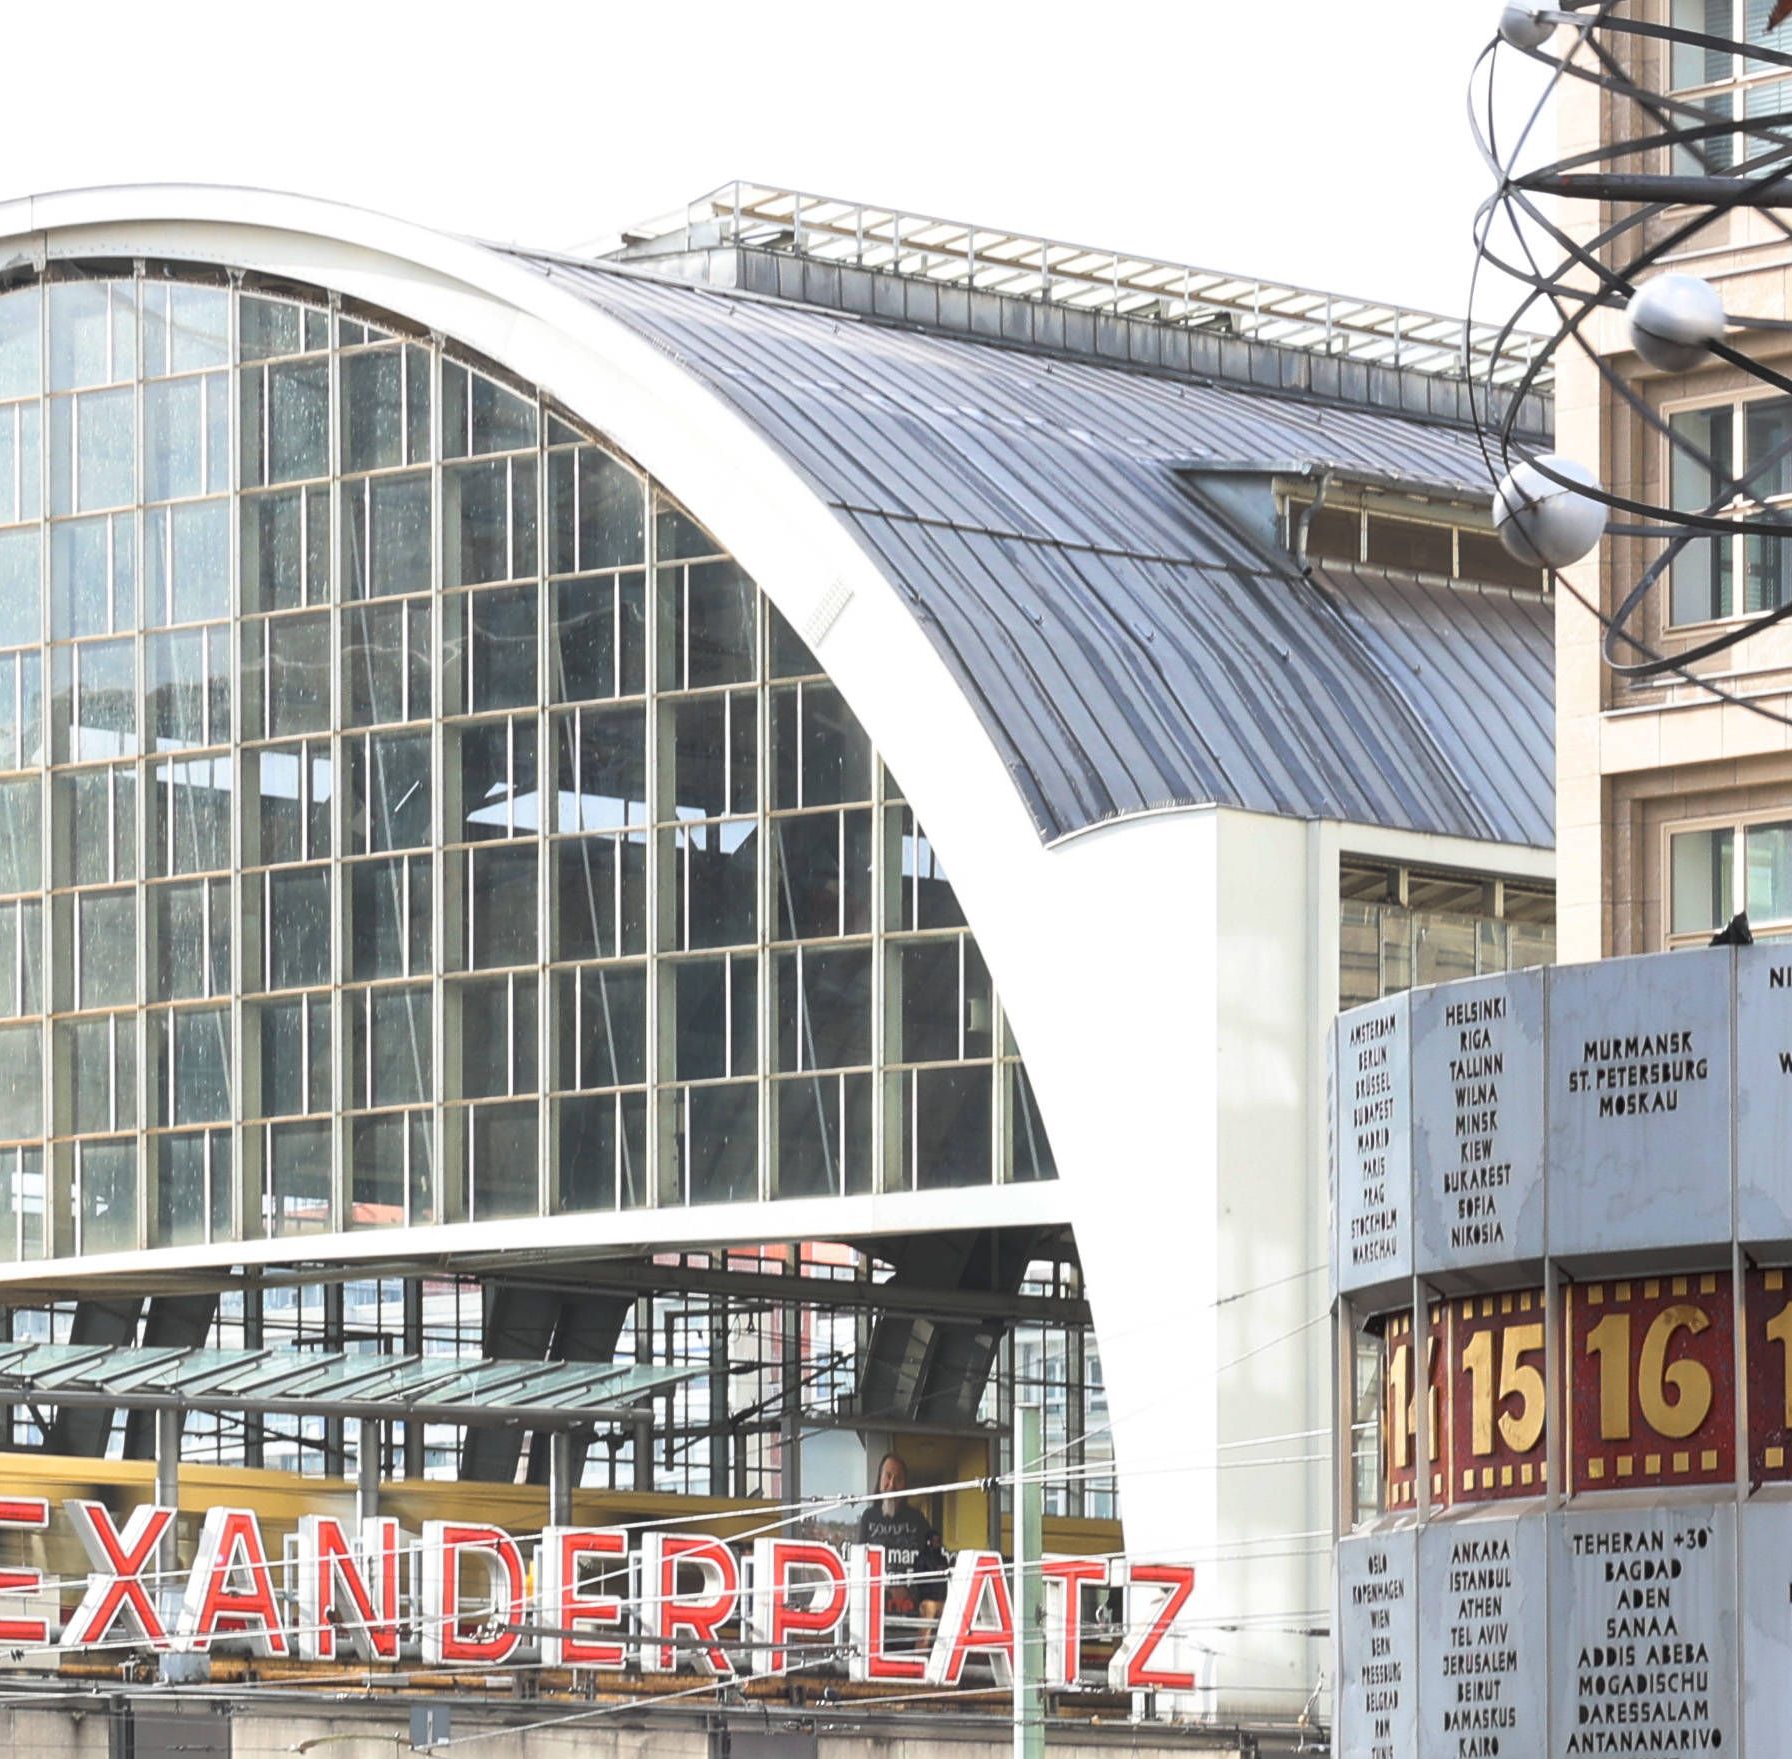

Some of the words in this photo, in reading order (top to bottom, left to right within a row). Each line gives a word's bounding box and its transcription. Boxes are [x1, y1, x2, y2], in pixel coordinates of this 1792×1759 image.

[1445, 996, 1507, 1027] HELSINKI
[1350, 1014, 1396, 1044] AMSTERDAM
[1460, 1028, 1492, 1053] RIGA
[1358, 1046, 1387, 1072] BERLIN
[1583, 1031, 1693, 1063] MURMANSK
[1449, 1052, 1503, 1082] TALLINN
[1569, 1069, 1592, 1093] ST.
[1593, 1051, 1708, 1090] PETERSBURG
[1355, 1071, 1391, 1101] BRÜSSEL
[1455, 1082, 1498, 1108] WILNA
[1353, 1097, 1394, 1128] BUDAPEST
[1599, 1089, 1678, 1118] MOSKAU
[1455, 1109, 1498, 1137] MINSK
[1357, 1127, 1390, 1151] MADRID
[1461, 1138, 1493, 1164] KIEW
[1363, 1156, 1385, 1179] PARIS
[1444, 1163, 1512, 1194] BUKAREST
[1363, 1183, 1385, 1207] PRAG
[1458, 1195, 1496, 1220] SOFIA
[1351, 1208, 1397, 1239] STOCKHOLM
[1451, 1222, 1504, 1248] NIKOSIA
[1351, 1233, 1397, 1265] WARSCHAU
[1587, 1304, 1713, 1440] 16
[1462, 1323, 1546, 1457] 15
[1451, 1539, 1510, 1565] ANKARA
[1572, 1530, 1664, 1555] TEHERAN
[1368, 1553, 1387, 1575] OSLO
[1605, 1558, 1682, 1583] BAGDAD
[1352, 1579, 1405, 1605] KOPENHAGEN
[1449, 1567, 1512, 1593] ISTANBUL
[1458, 1596, 1502, 1620] ATHEN
[1617, 1587, 1670, 1610] ADEN
[1370, 1609, 1390, 1629] WIEN
[1606, 1615, 1678, 1639] SANAA
[1371, 1637, 1391, 1658] BERN
[1450, 1626, 1473, 1648] TEL
[1477, 1623, 1509, 1646] AVIV
[1443, 1650, 1518, 1676] JERUSALEM
[1577, 1644, 1636, 1669] ADDIS
[1646, 1643, 1709, 1666] ABEBA
[1361, 1661, 1402, 1686] PRESSBURG
[1578, 1671, 1708, 1697] MOGADISCHU
[1366, 1689, 1399, 1713] BELGRAD
[1457, 1679, 1501, 1703] BEIRUT
[1444, 1706, 1516, 1732] DAMASKUS
[1578, 1699, 1709, 1725] DARESSALAM
[1375, 1719, 1390, 1739] ROM
[1566, 1728, 1722, 1754] ANTANANARIVO
[1459, 1735, 1499, 1759] KAIRO
